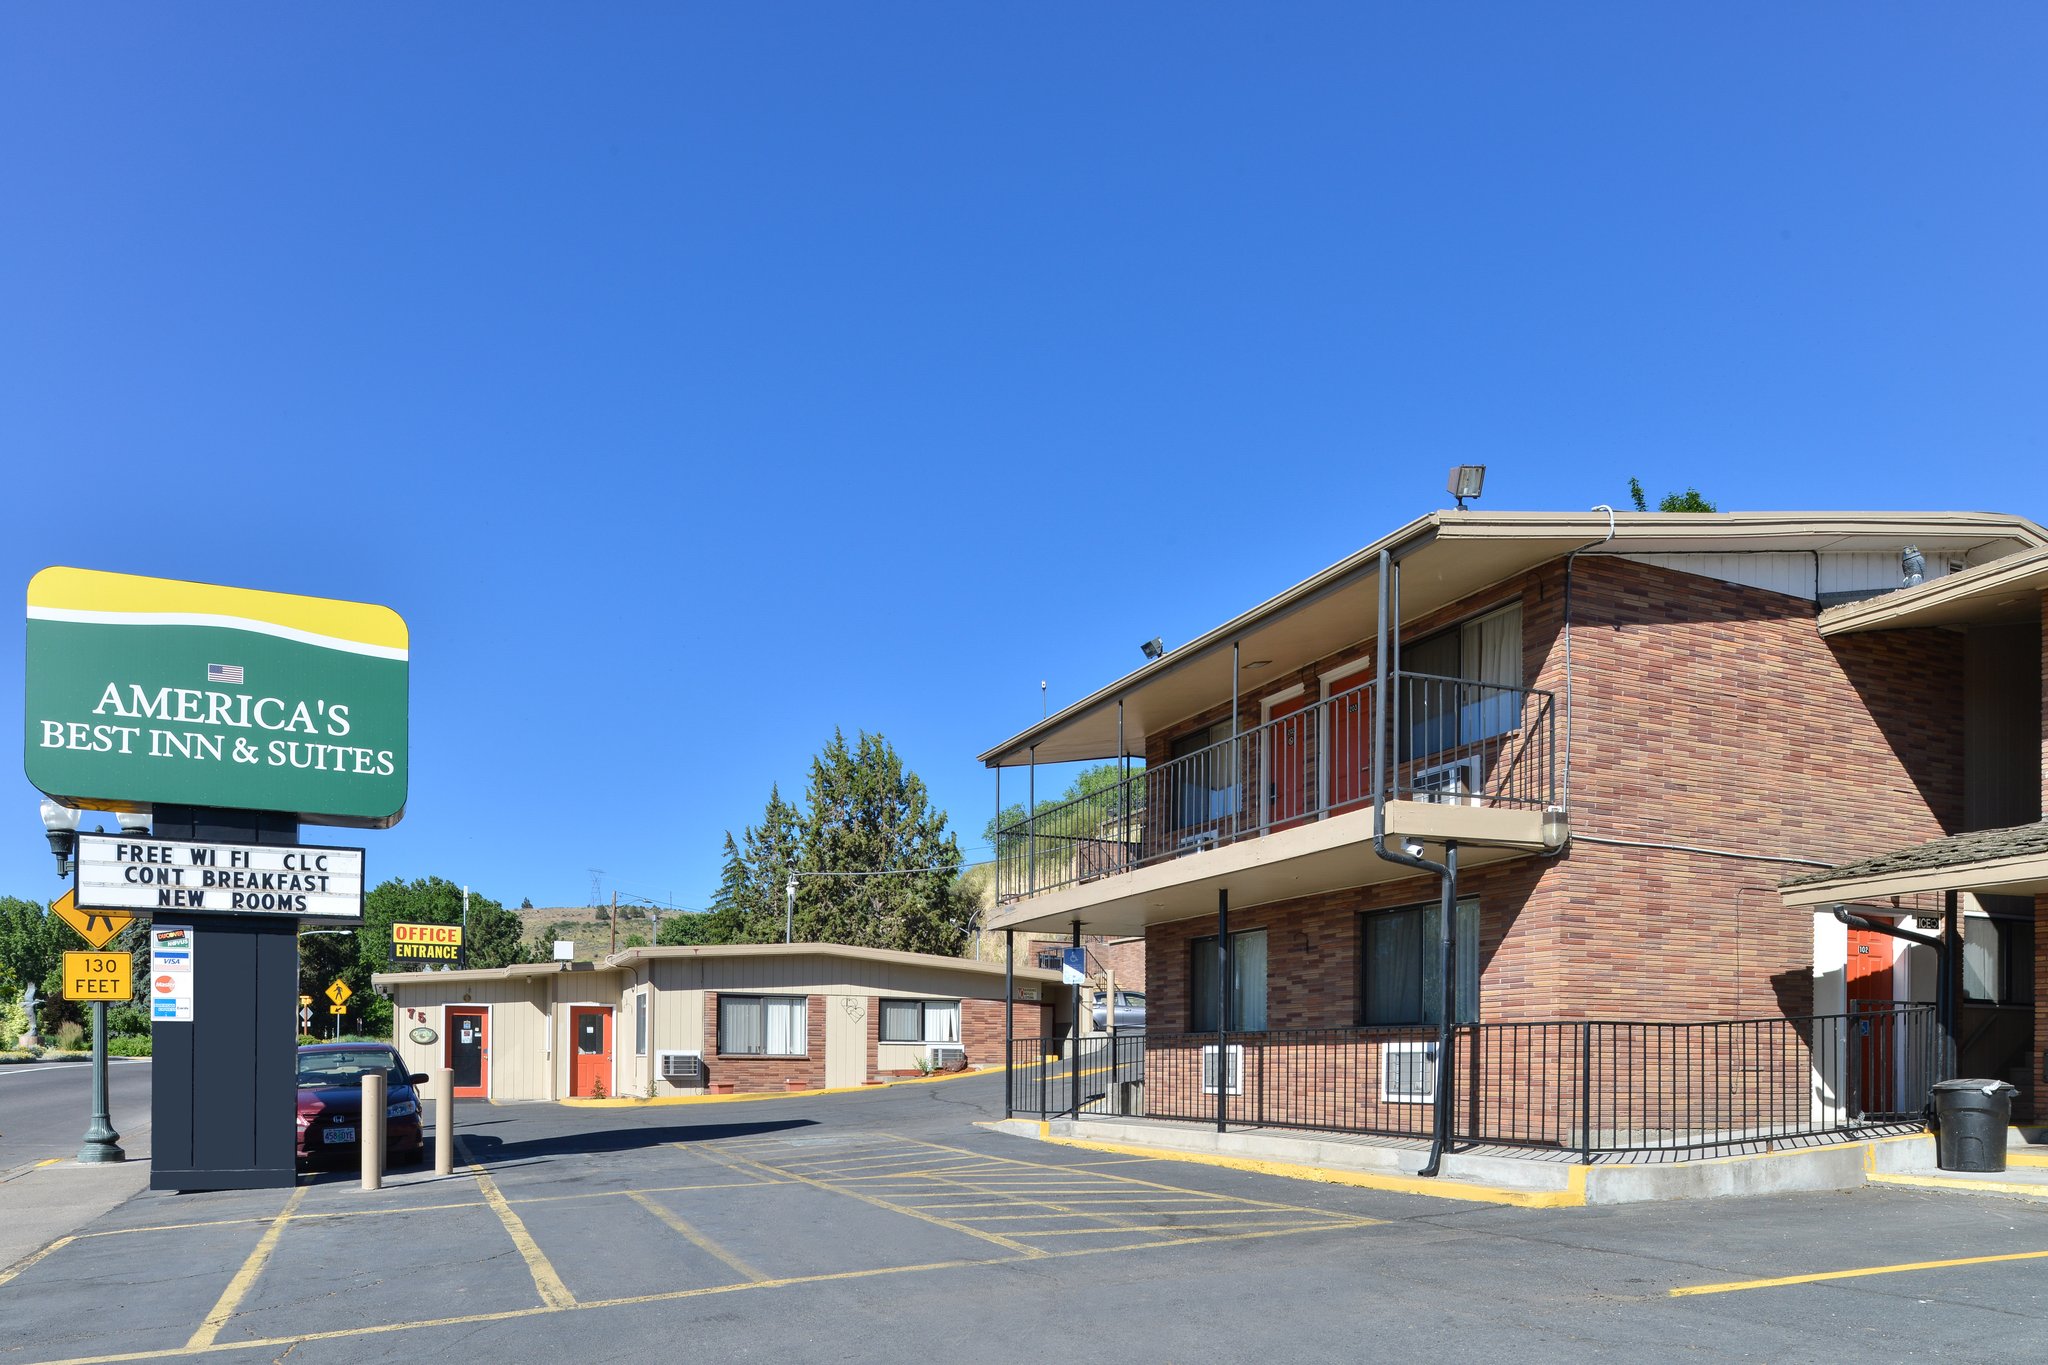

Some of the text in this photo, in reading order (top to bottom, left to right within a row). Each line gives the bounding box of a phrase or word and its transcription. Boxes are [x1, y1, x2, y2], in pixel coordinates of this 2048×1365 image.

[92, 682, 350, 736] AMERICA'S
[40, 720, 394, 776] BEST INN & SUITES
[117, 844, 327, 871] FREE WI FI CLC
[124, 866, 329, 892] CONT BREAKFAST
[158, 889, 307, 911] NEW ROOMS
[1918, 918, 1931, 928] ICE
[396, 926, 457, 943] OFFICE
[396, 944, 458, 959] ENTRANCE
[1859, 946, 1869, 954] 102
[85, 958, 117, 973] 130
[76, 979, 120, 993] FEET
[407, 1008, 426, 1024] 75
